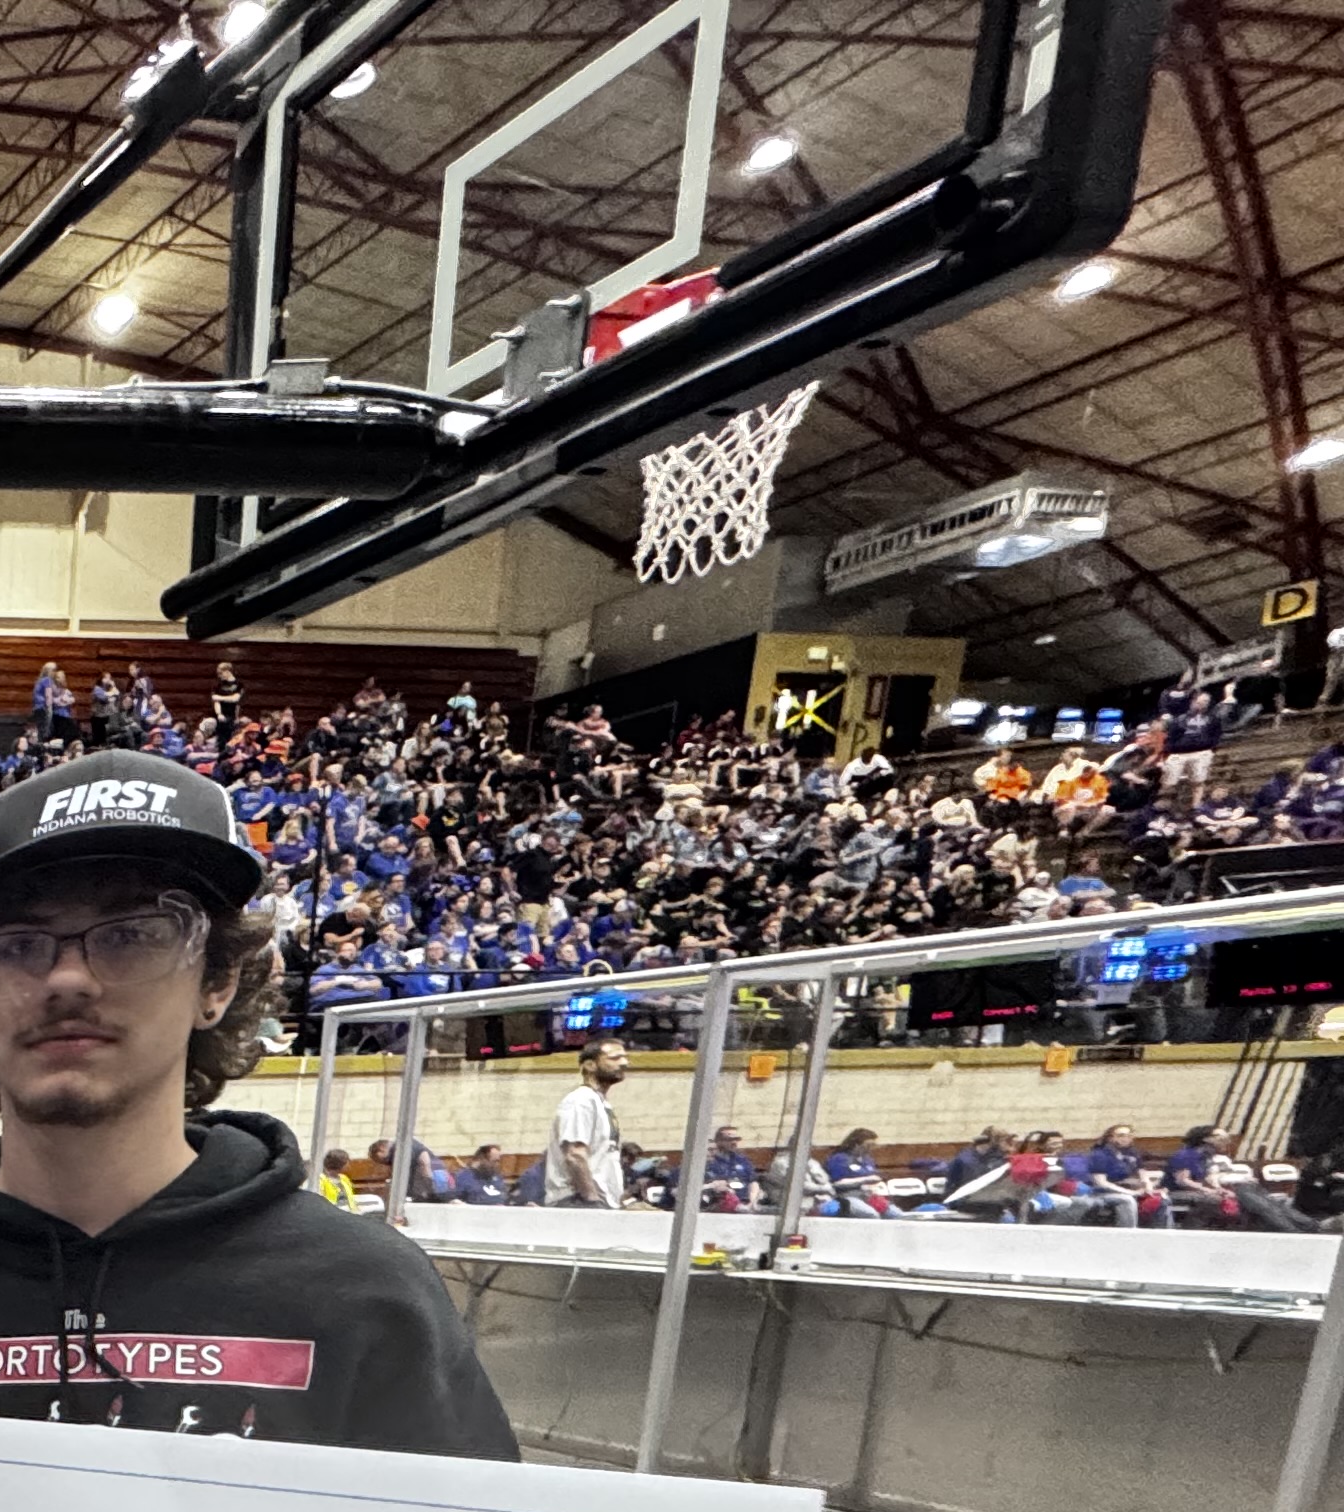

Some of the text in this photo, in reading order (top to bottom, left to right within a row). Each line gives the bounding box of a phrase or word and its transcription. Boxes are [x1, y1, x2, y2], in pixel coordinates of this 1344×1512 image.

[1272, 588, 1309, 620] D
[39, 779, 178, 824] FIRST
[32, 808, 182, 838] INDIANA ROBOTICS
